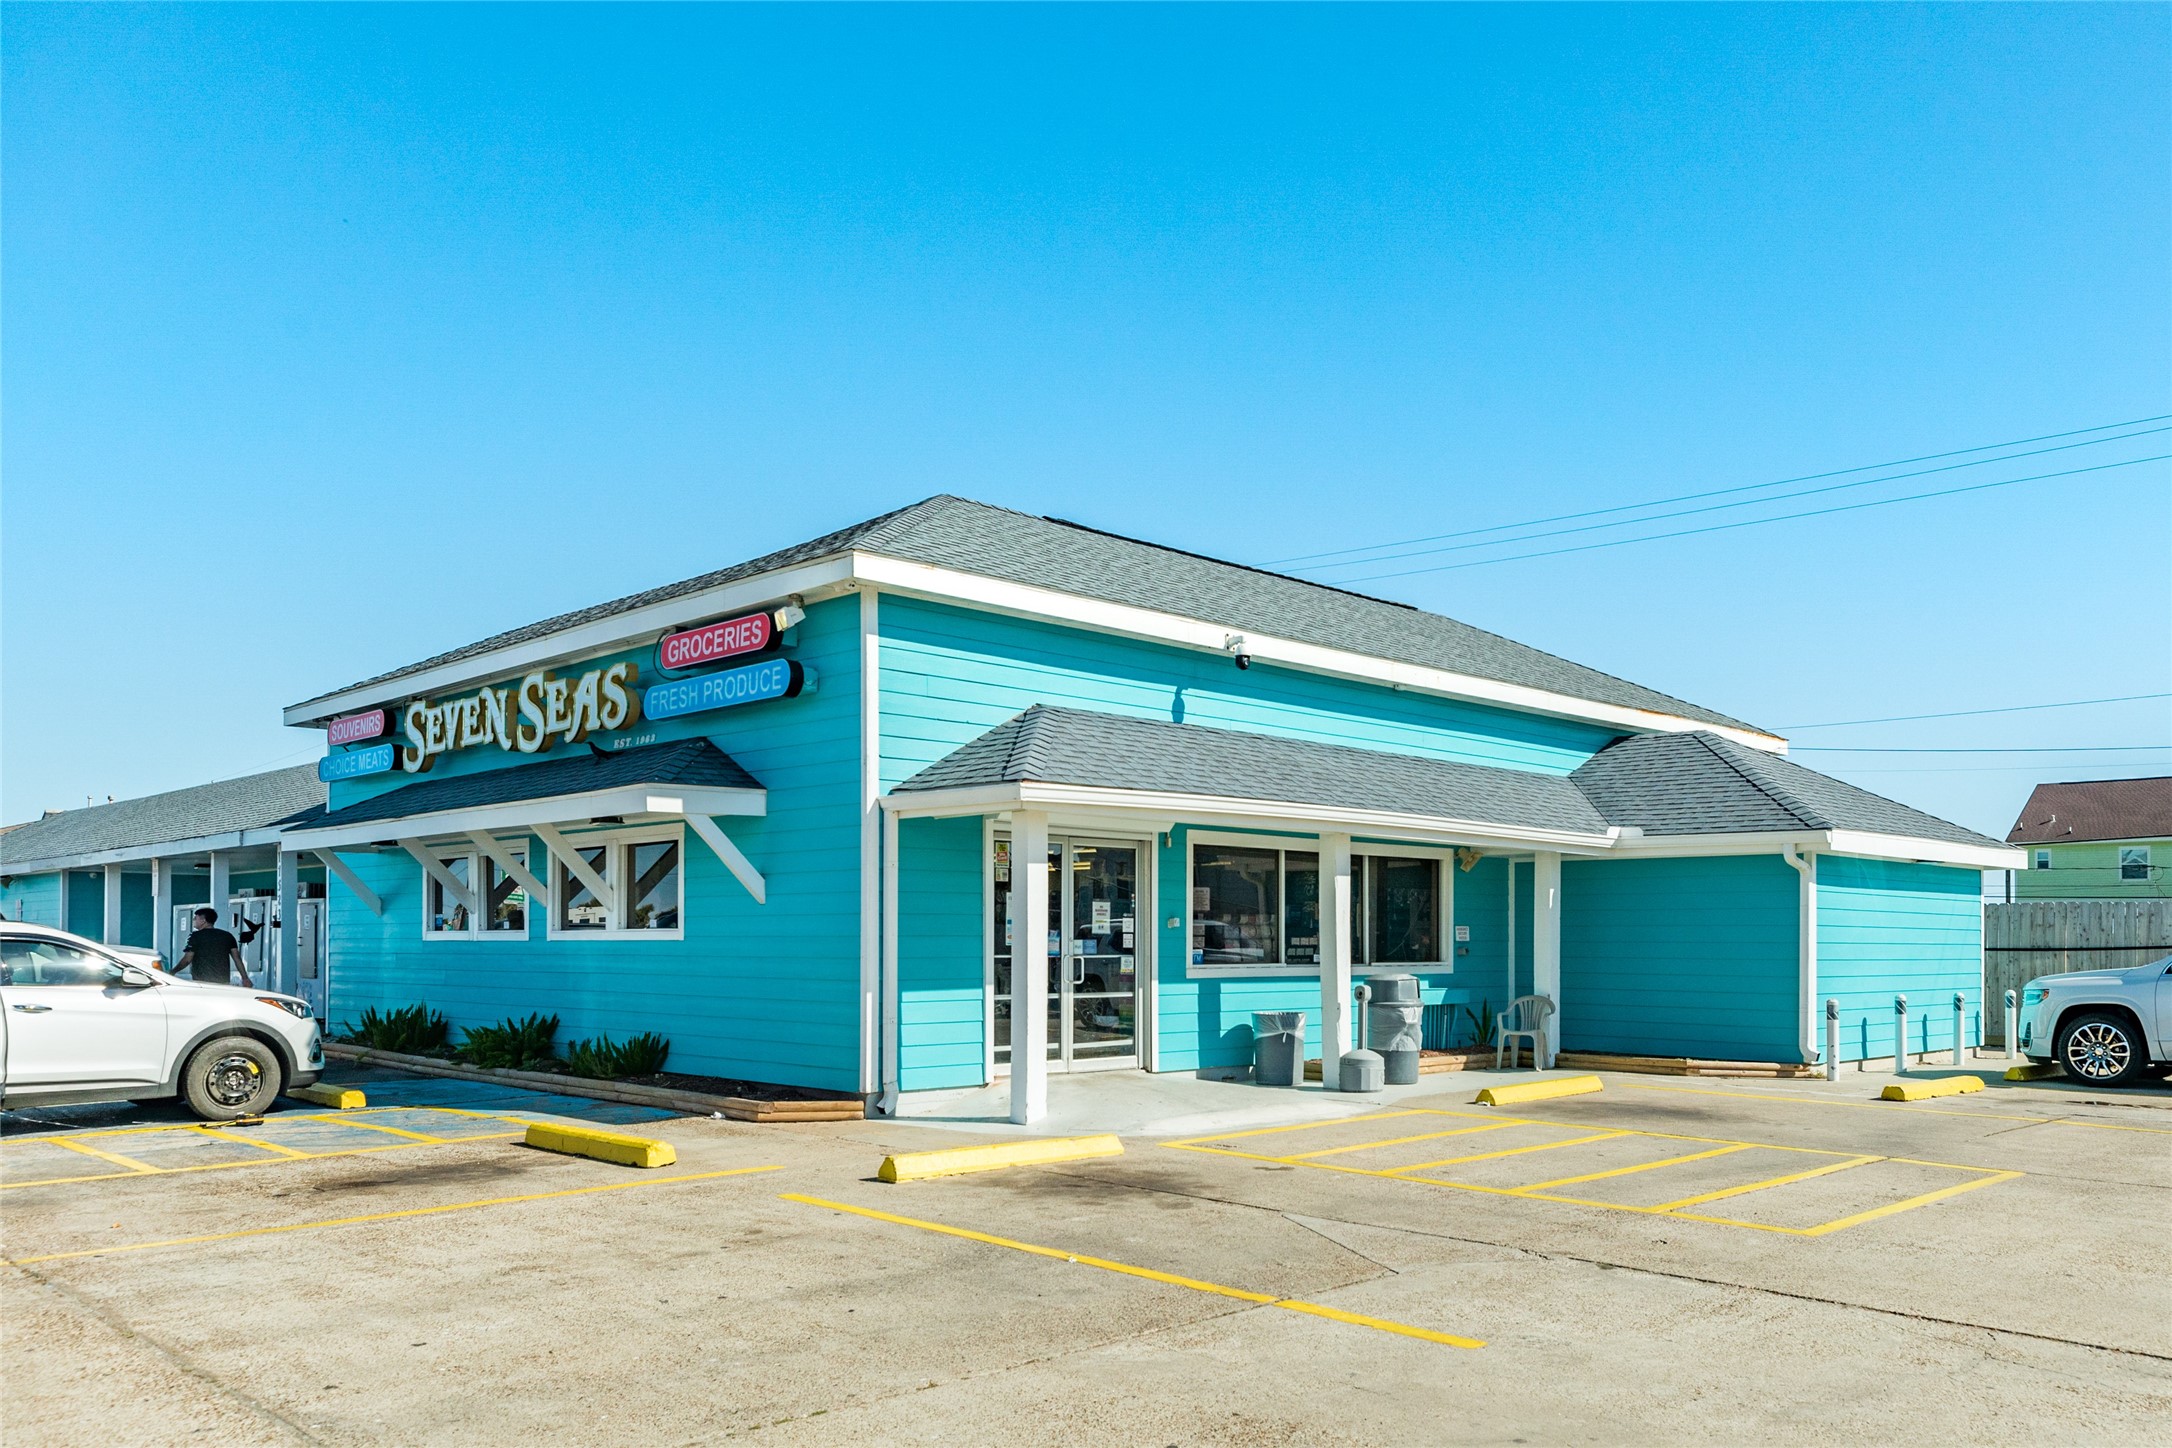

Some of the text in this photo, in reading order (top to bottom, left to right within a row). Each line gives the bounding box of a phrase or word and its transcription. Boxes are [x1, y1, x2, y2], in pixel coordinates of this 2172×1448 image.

[668, 620, 762, 663] GROCERIES
[651, 666, 782, 714] FRESH PRODUCE
[331, 714, 381, 741] SOUVENIRS
[403, 662, 628, 773] SEVEN SEAS
[323, 749, 389, 777] CHOICE MEATS
